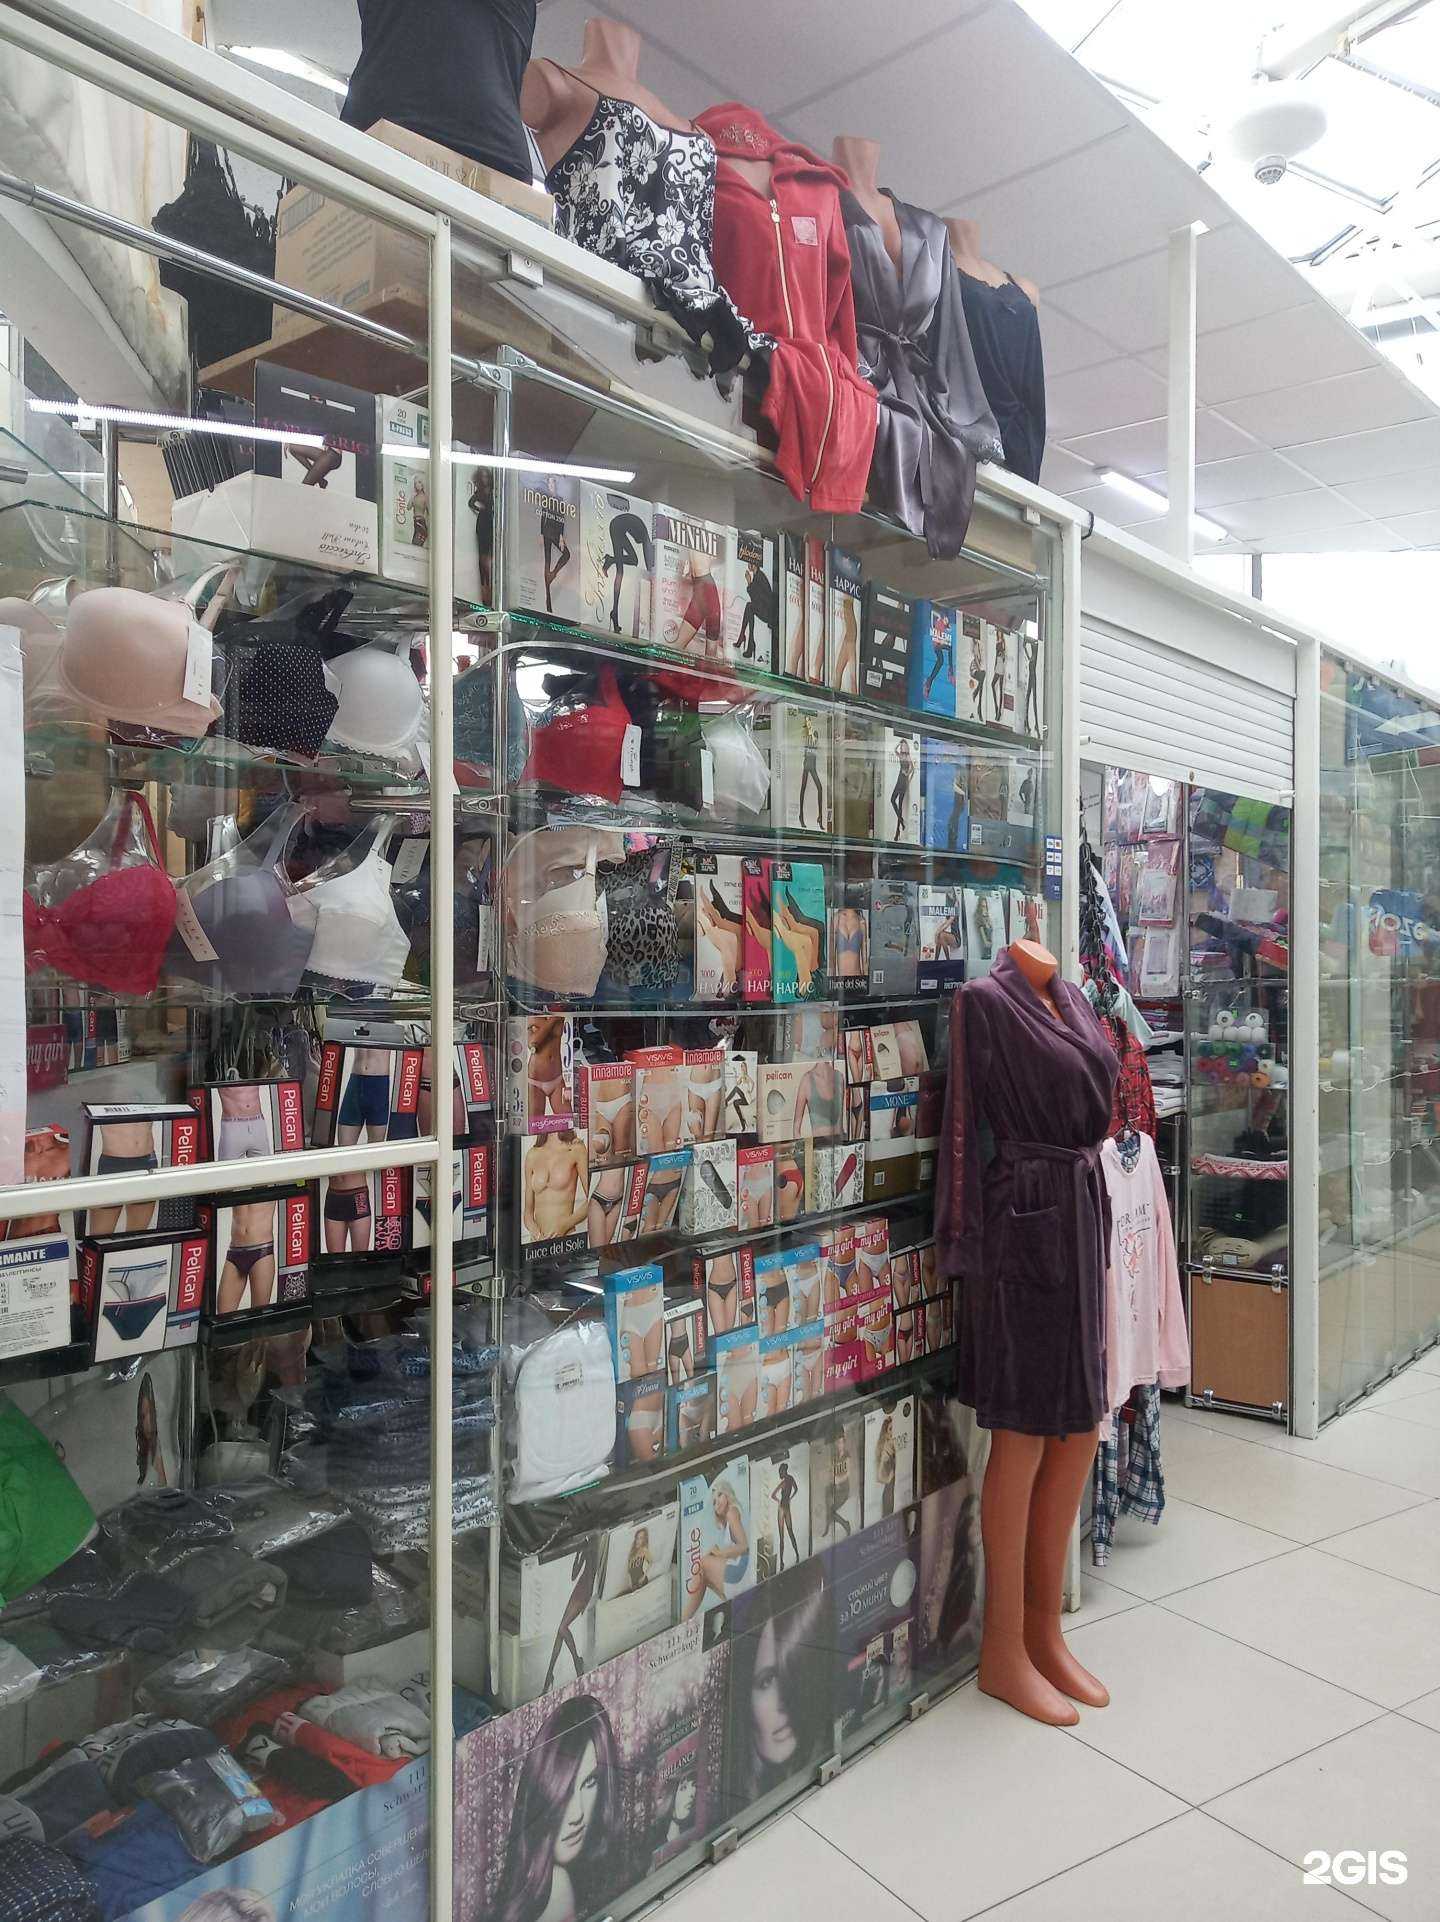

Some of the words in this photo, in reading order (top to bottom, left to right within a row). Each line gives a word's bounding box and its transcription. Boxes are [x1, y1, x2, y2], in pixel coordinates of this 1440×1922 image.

[524, 488, 576, 518] innamore
[747, 980, 773, 993] НАР
[320, 1051, 336, 1102] Pelican
[469, 1049, 484, 1096] Pelican
[593, 1065, 633, 1079] innamore
[687, 1053, 722, 1065] innamore
[766, 1070, 793, 1081] pelican
[403, 1057, 418, 1106] Pelican
[284, 1089, 297, 1142] Pelican
[178, 1126, 193, 1168] Pelic
[386, 1167, 398, 1209] elican
[473, 1152, 484, 1201] Pelican
[631, 1168, 645, 1210] Pelican
[292, 1203, 305, 1257] Pelican
[525, 1246, 548, 1261] Luce
[549, 1240, 564, 1255] del
[565, 1237, 585, 1252] Sole
[184, 1246, 202, 1303] Pelican
[742, 1253, 752, 1294] Pelican
[685, 1527, 702, 1594] Conte
